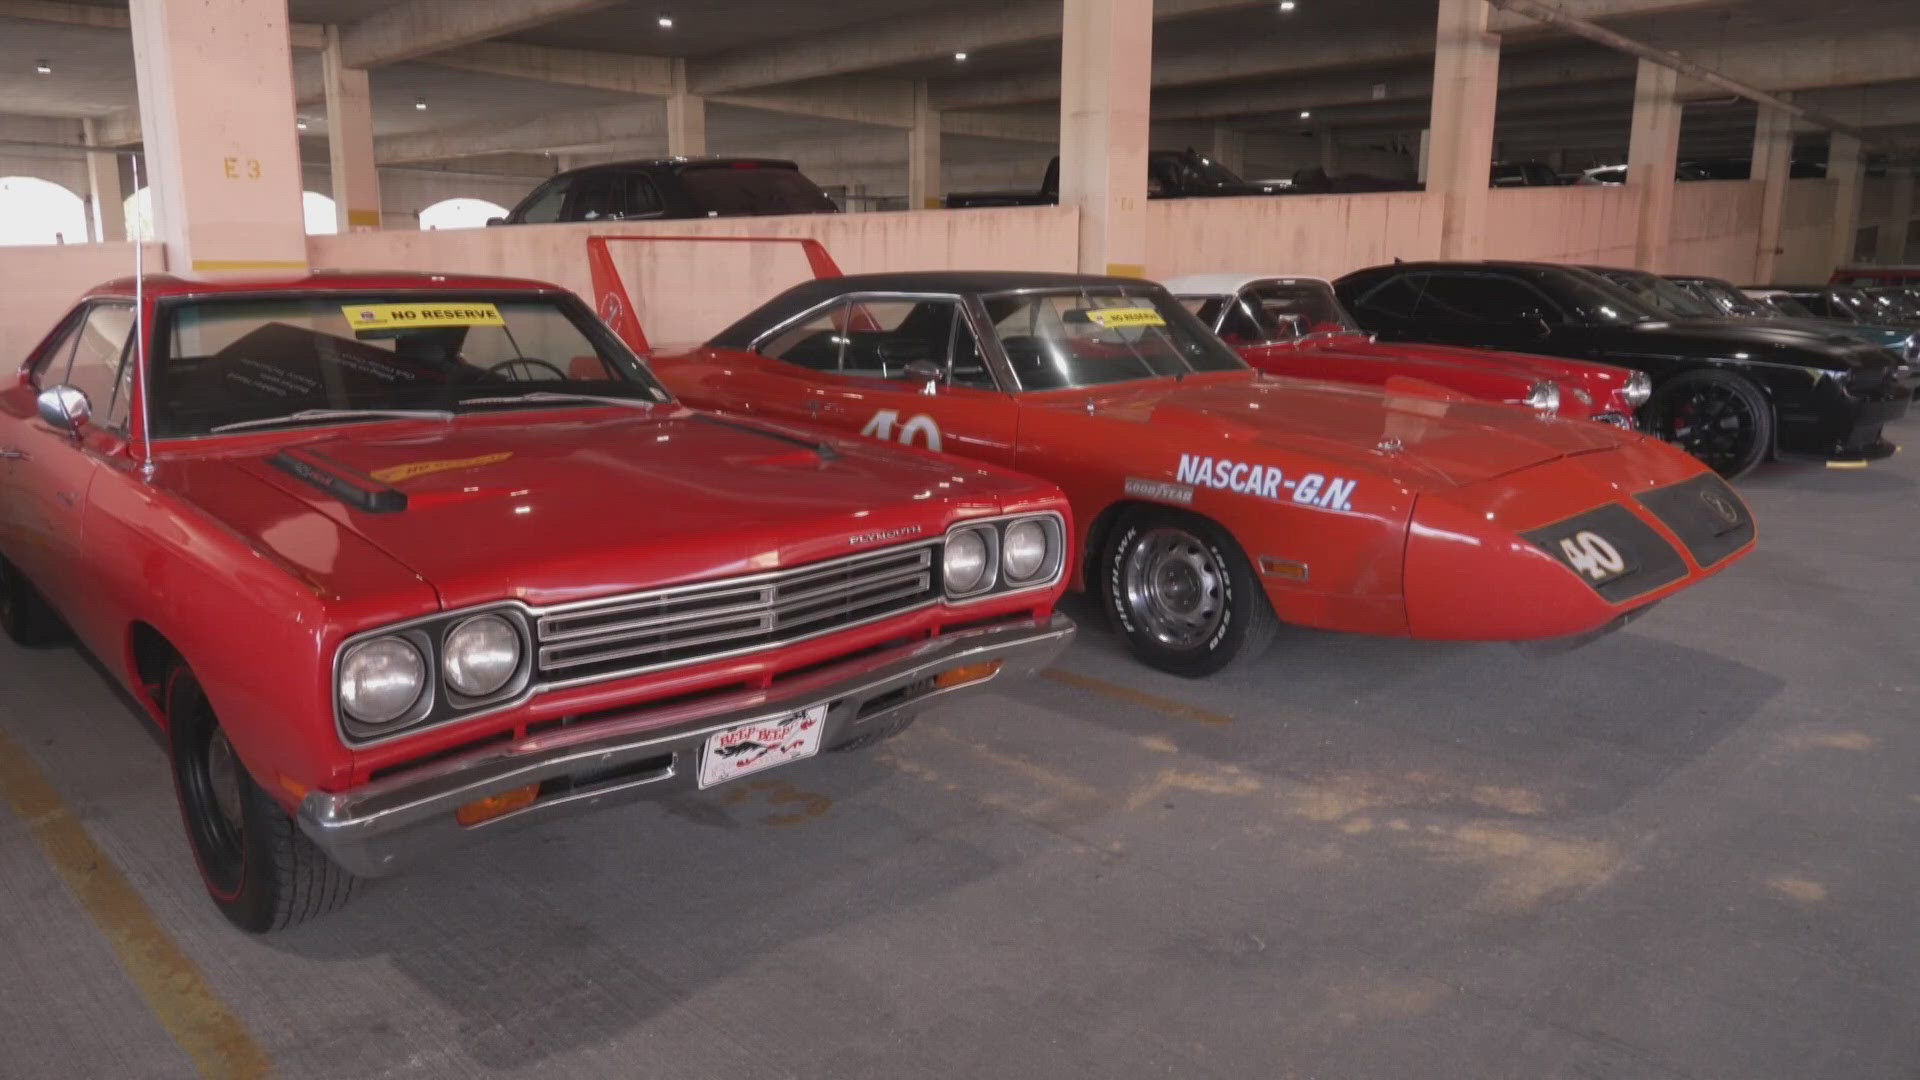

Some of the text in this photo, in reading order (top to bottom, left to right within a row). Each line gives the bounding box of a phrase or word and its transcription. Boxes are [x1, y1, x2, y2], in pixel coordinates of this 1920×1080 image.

[391, 311, 416, 320] NO
[421, 309, 496, 319] RESERVE
[1125, 478, 1193, 503] GOODYEAR
[848, 525, 921, 545] PLYMOUTH
[1560, 531, 1624, 580] 40
[1112, 526, 1137, 633] FIREHAWK
[1209, 609, 1231, 651] 500
